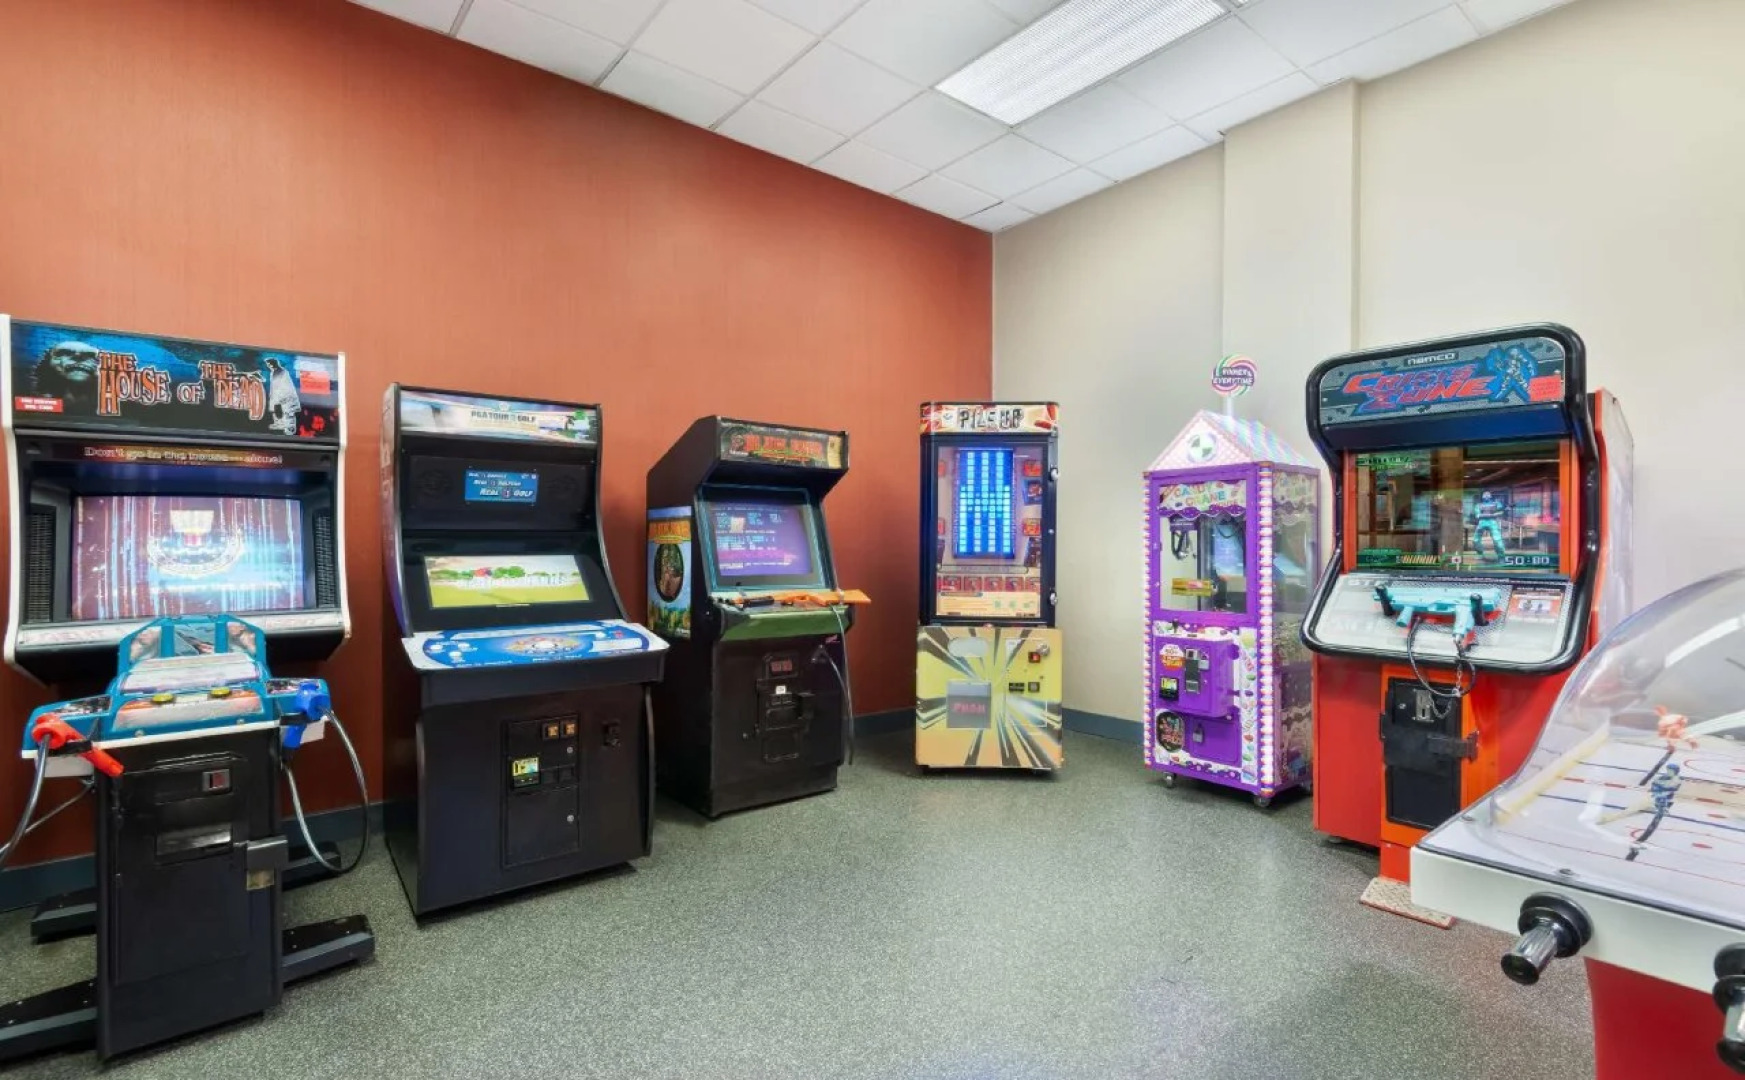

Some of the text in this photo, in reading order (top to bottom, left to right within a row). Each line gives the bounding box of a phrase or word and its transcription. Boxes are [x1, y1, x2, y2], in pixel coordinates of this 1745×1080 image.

[100, 352, 137, 371] THE
[200, 360, 234, 380] THE
[98, 367, 205, 416] HOUSE OF
[214, 371, 266, 420] DEAD
[1000, 407, 1025, 430] UP
